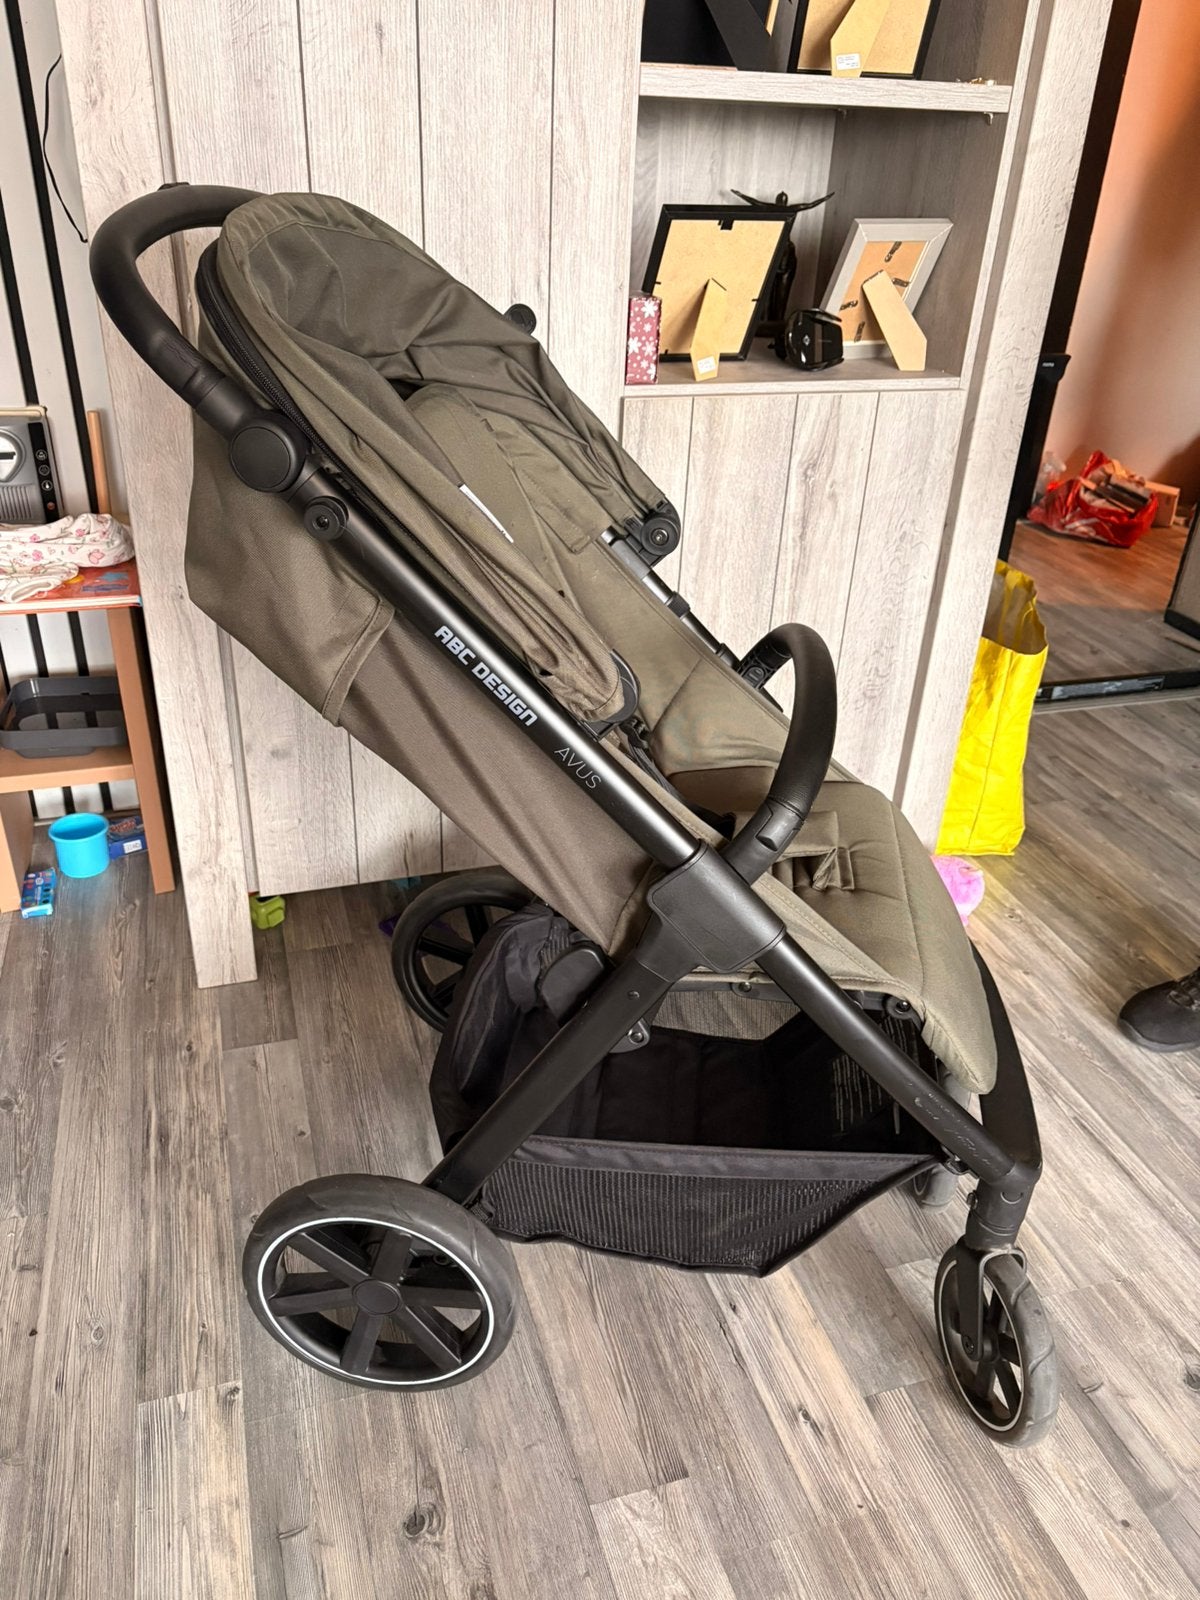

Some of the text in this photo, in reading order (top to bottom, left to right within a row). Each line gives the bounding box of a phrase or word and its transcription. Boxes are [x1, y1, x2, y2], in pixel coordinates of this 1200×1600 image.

[434, 625, 538, 727] ABC DESIGN
[554, 747, 602, 789] AVUS
